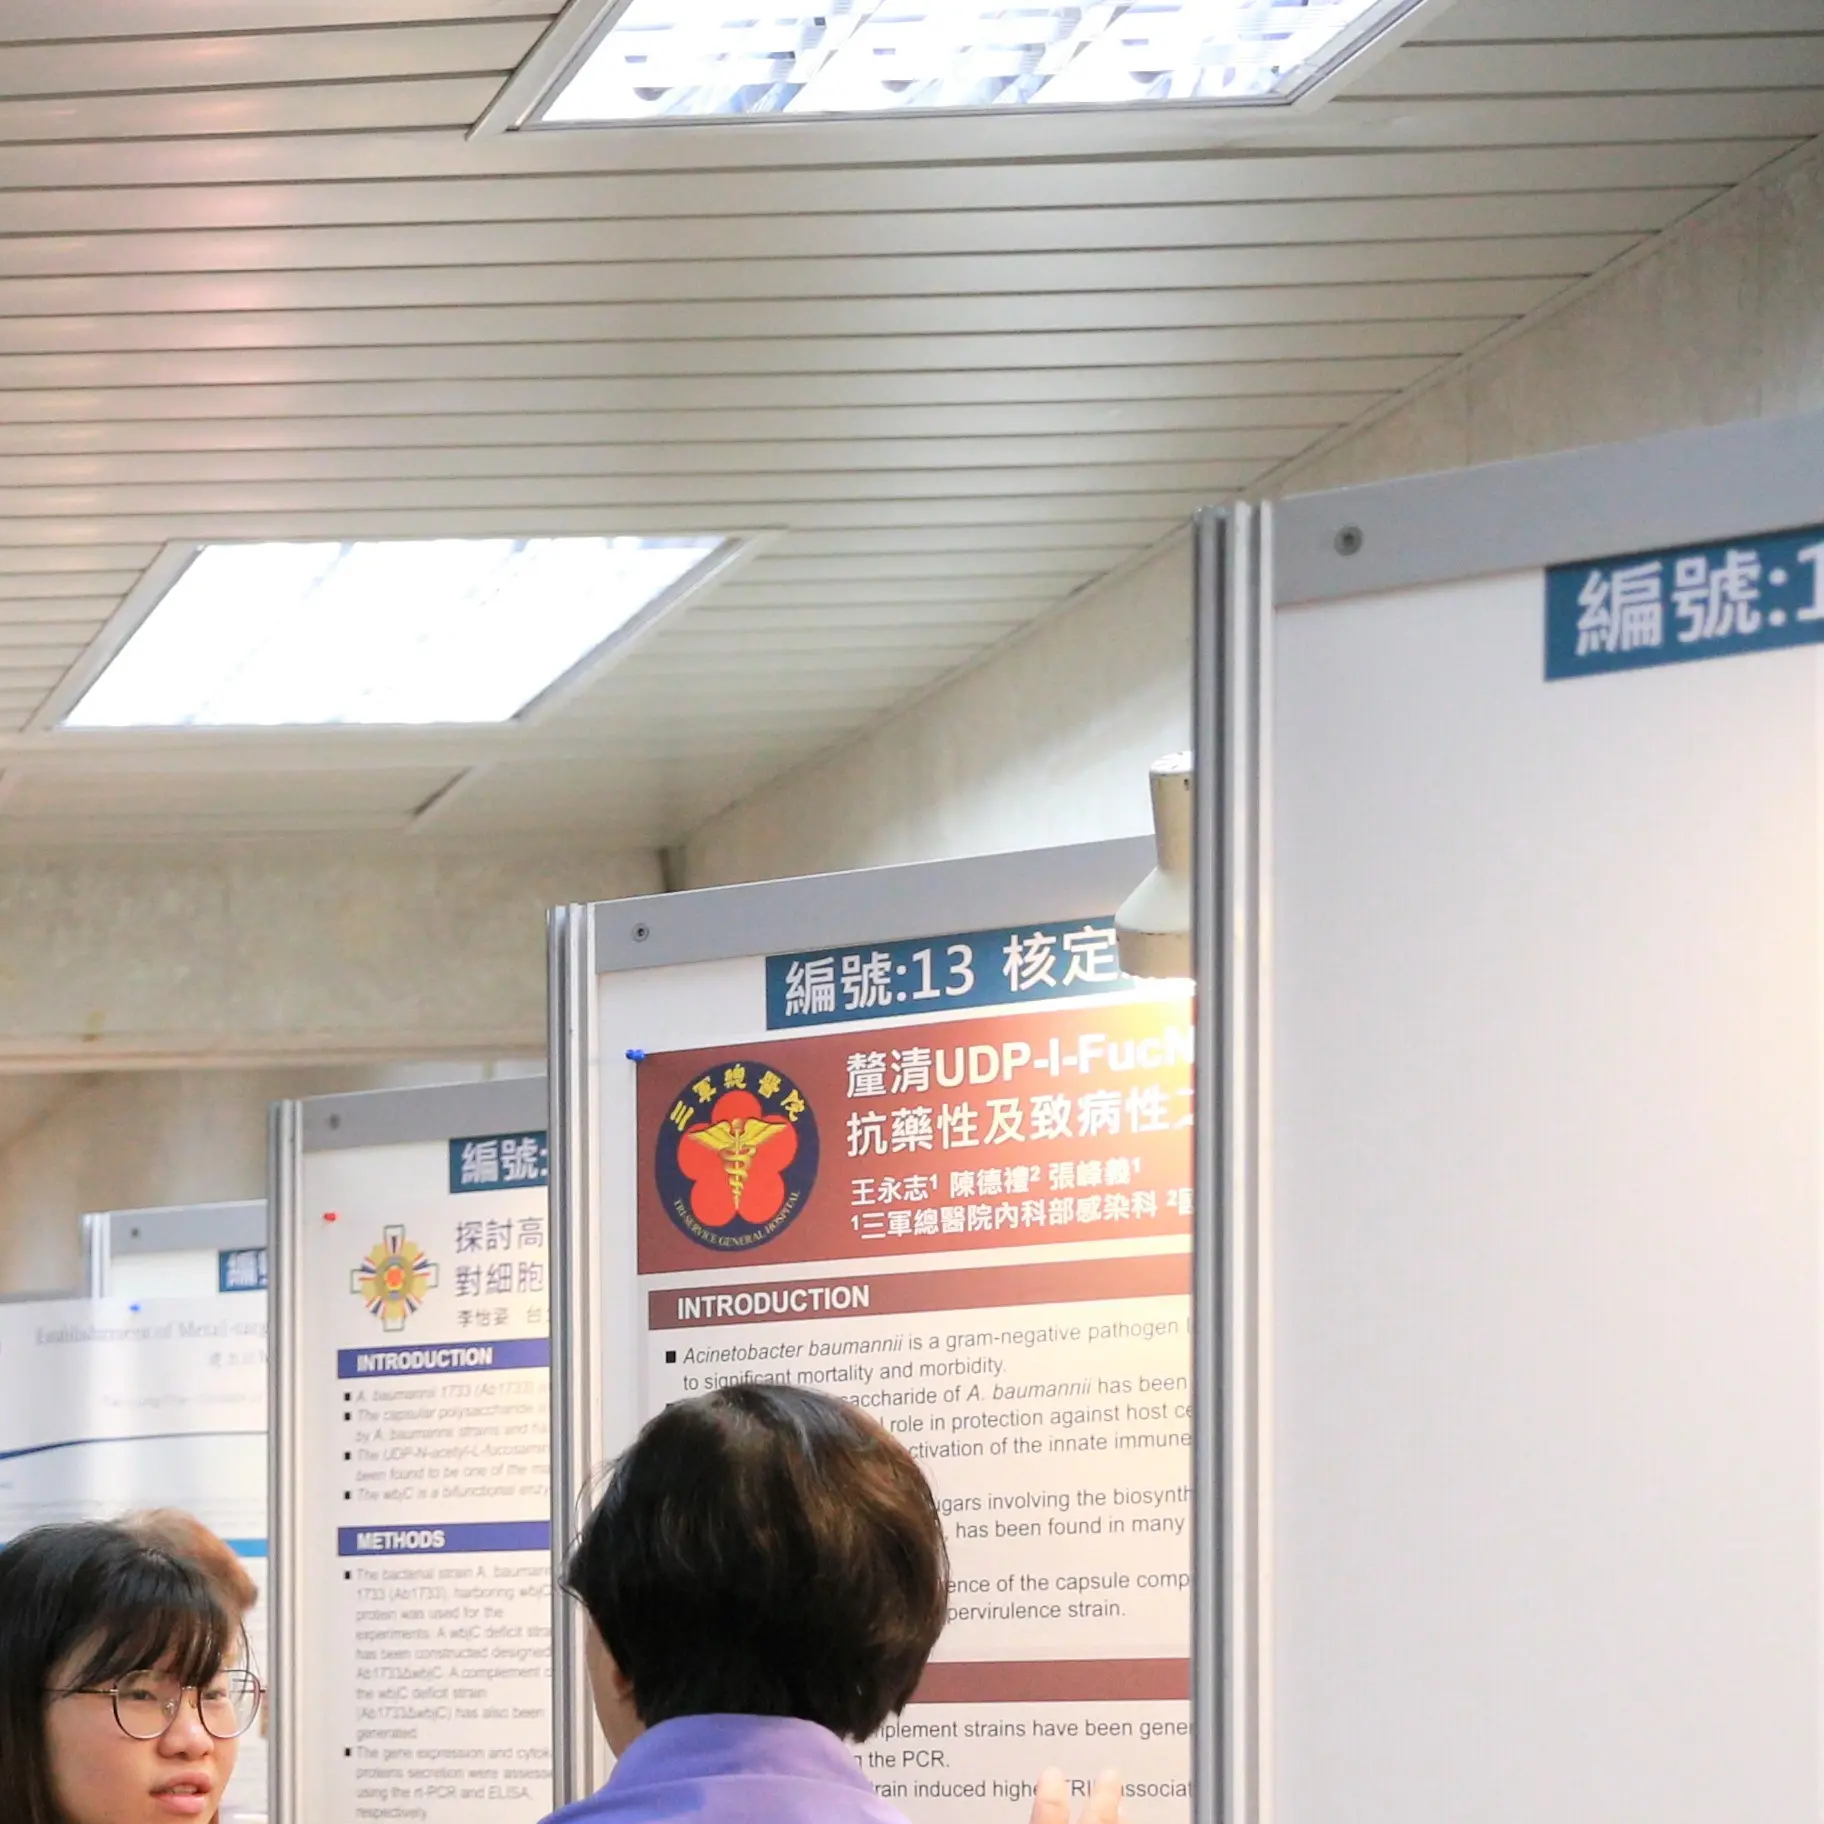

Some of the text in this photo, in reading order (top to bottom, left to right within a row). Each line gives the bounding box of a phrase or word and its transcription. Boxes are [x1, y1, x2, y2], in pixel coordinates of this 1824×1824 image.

[677, 1284, 870, 1320] INTRODUCTION
[683, 1319, 1179, 1365] Acinetobacter baumannii is a gram-negative pathogen
[357, 1347, 494, 1372] INTRODUCTION
[683, 1374, 699, 1391] to
[797, 1364, 874, 1385] mortality
[880, 1361, 913, 1379] and
[919, 1357, 1007, 1378] morbidity.
[943, 1385, 961, 1404] of
[966, 1384, 986, 1402] A.
[992, 1377, 1092, 1400] baumannii
[1097, 1377, 1133, 1395] has
[1138, 1375, 1188, 1393] been
[890, 1414, 924, 1433] role
[930, 1413, 946, 1431] in
[951, 1409, 1044, 1434] protection
[1049, 1405, 1121, 1429] against
[1126, 1403, 1169, 1422] host
[990, 1437, 1009, 1456] of
[1013, 1435, 1043, 1455] the
[1049, 1434, 1108, 1453] innate
[1114, 1430, 1193, 1449] immune
[988, 1491, 1071, 1512] involving
[1076, 1488, 1107, 1507] the
[955, 1515, 1186, 1539] has been found in many
[357, 1530, 446, 1550] METHODS
[996, 1574, 1015, 1593] of
[1020, 1574, 1049, 1592] the
[1055, 1571, 1131, 1594] capsule
[1068, 1599, 1127, 1618] strain.
[964, 1720, 1133, 1738] strains have been
[868, 1750, 950, 1768] the PCR.
[914, 1780, 986, 1797] induced
